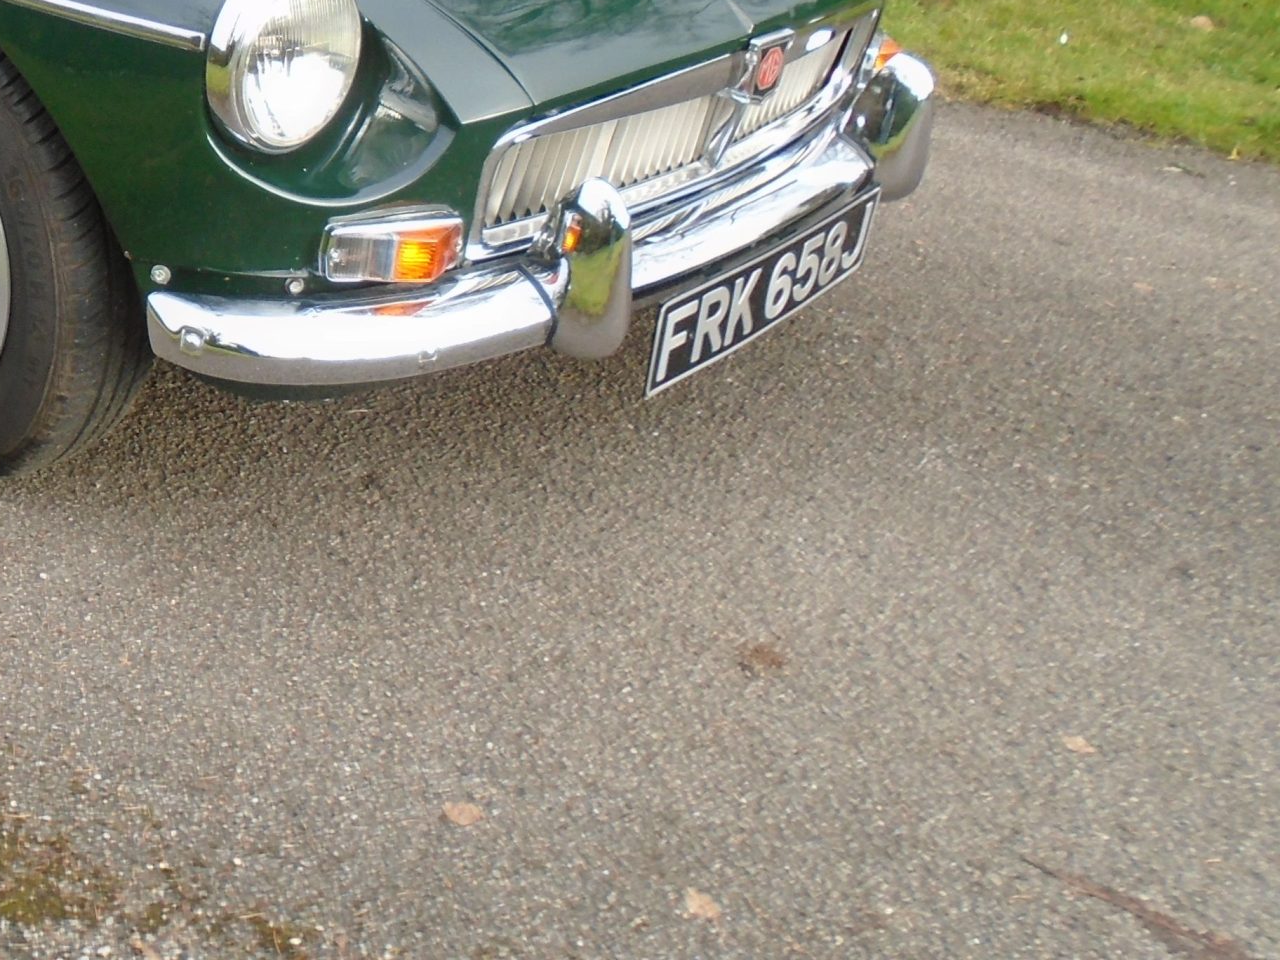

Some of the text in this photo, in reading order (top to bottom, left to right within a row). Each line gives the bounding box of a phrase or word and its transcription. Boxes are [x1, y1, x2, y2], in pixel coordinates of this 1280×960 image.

[758, 48, 782, 88] MG
[655, 201, 874, 382] FRK 658J
